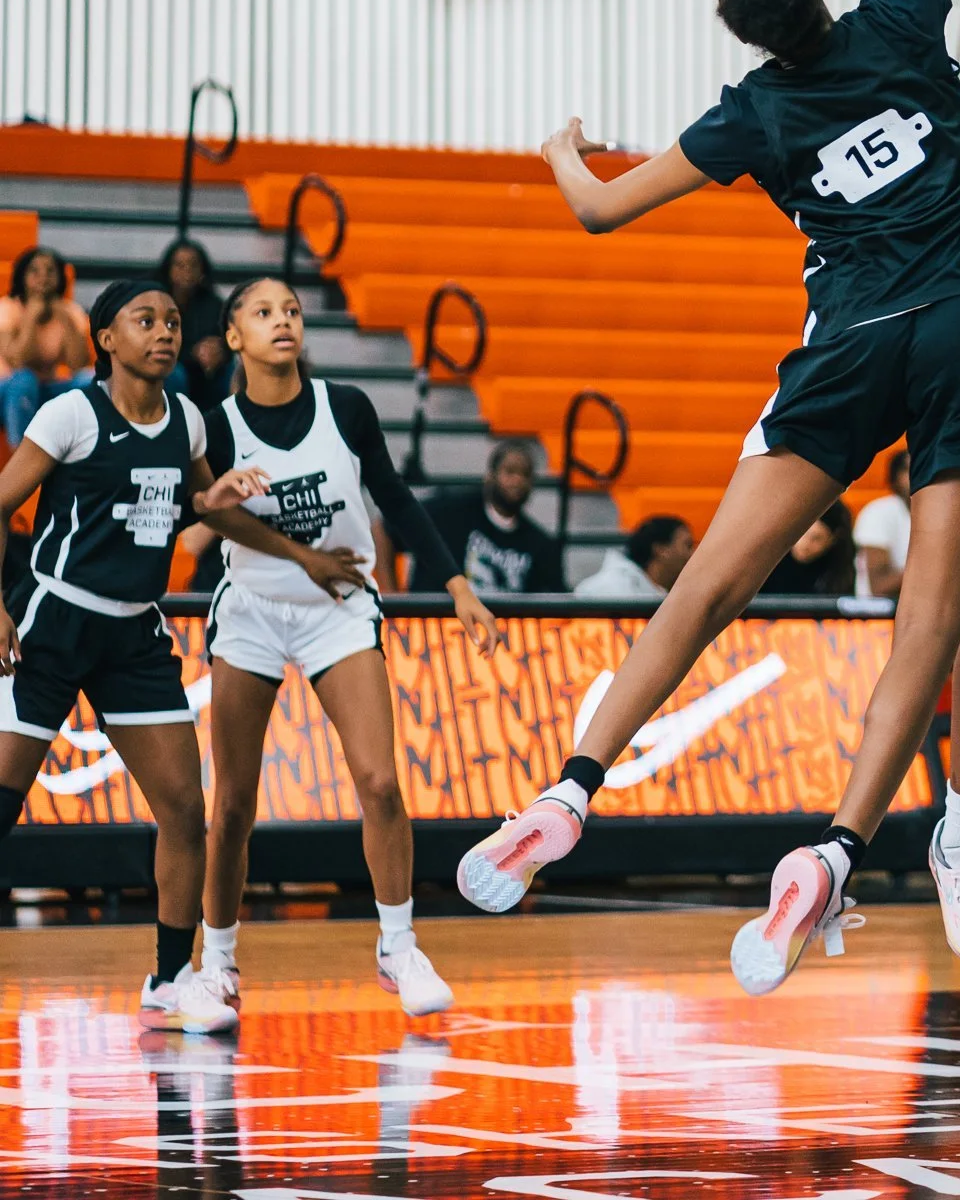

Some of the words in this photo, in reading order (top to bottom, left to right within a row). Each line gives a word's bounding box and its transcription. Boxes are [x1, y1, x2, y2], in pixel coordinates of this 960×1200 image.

[845, 127, 899, 179] 15
[143, 485, 171, 501] CHI
[282, 488, 317, 511] CHI
[126, 504, 173, 517] BASKETBA
[129, 518, 172, 529] ACADEM
